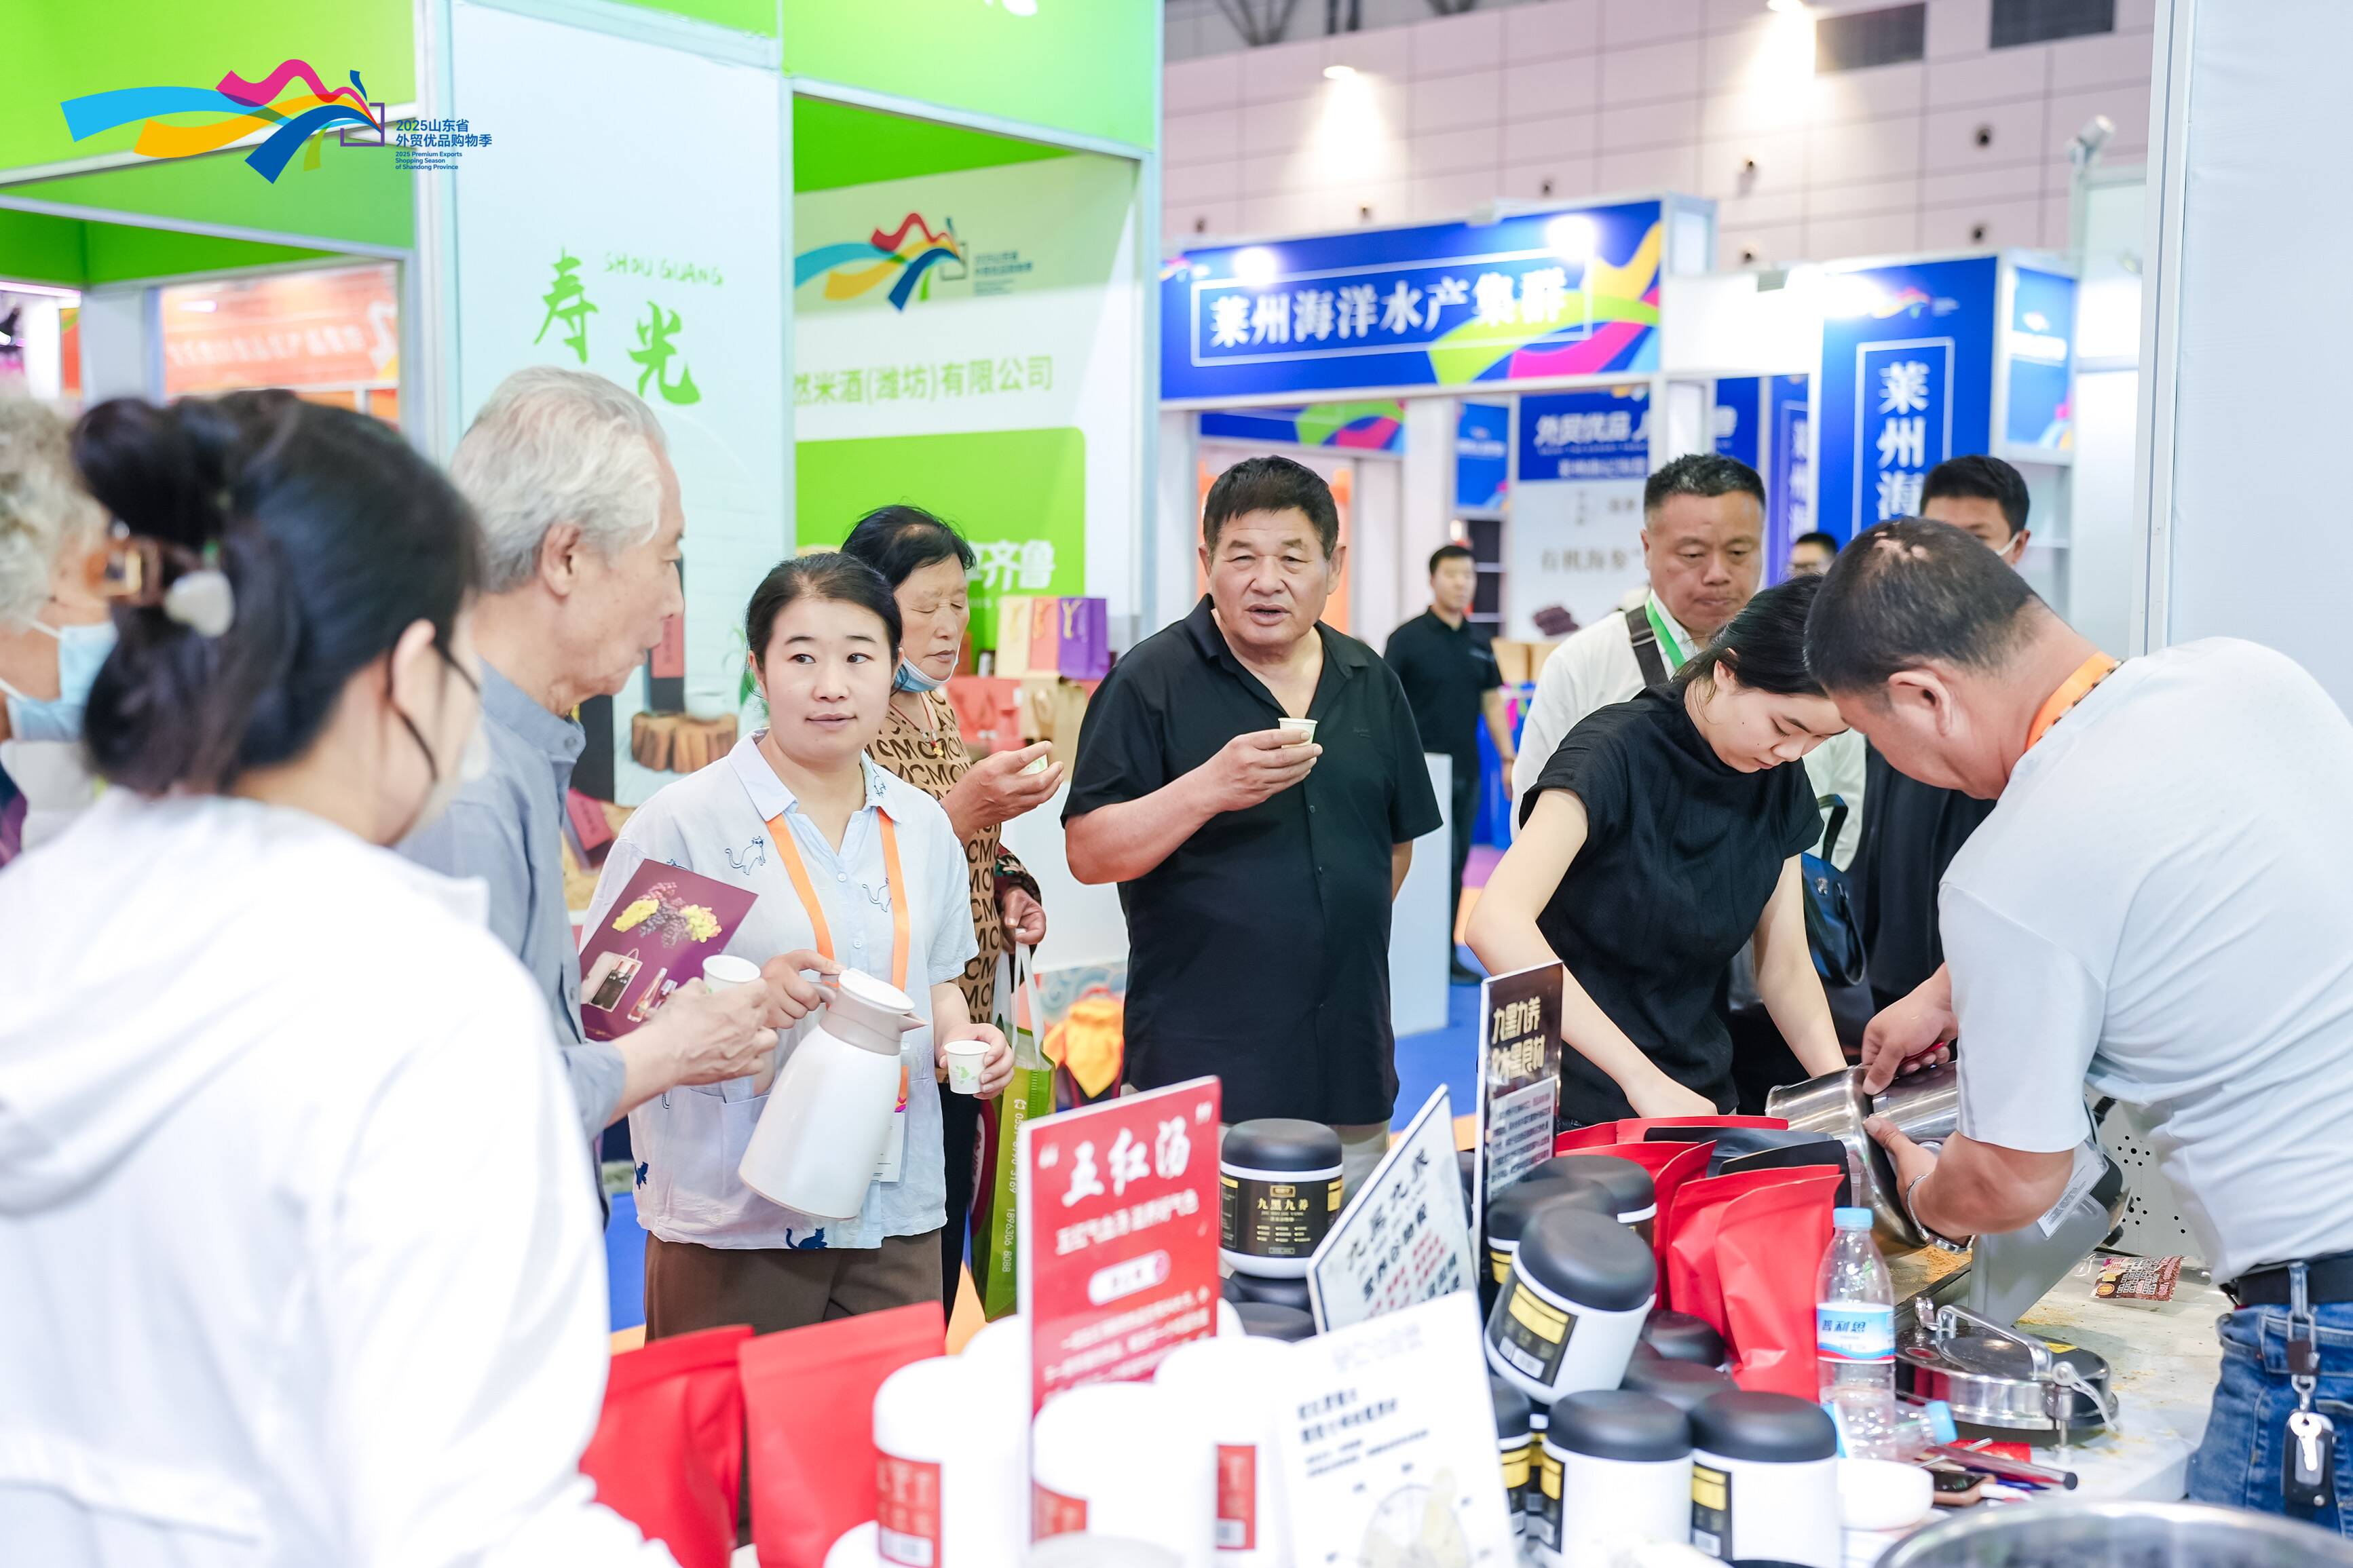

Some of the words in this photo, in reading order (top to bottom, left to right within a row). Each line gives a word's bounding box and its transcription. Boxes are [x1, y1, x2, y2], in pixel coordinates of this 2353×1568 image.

[604, 251, 654, 278] SHOU
[1210, 267, 1567, 348] 莱州海洋水产集群
[966, 539, 1057, 592] 齐鲁
[1492, 996, 1541, 1044] 九黑九养
[1004, 1208, 1015, 1246] 1896306
[1002, 1250, 1013, 1272] 8088
